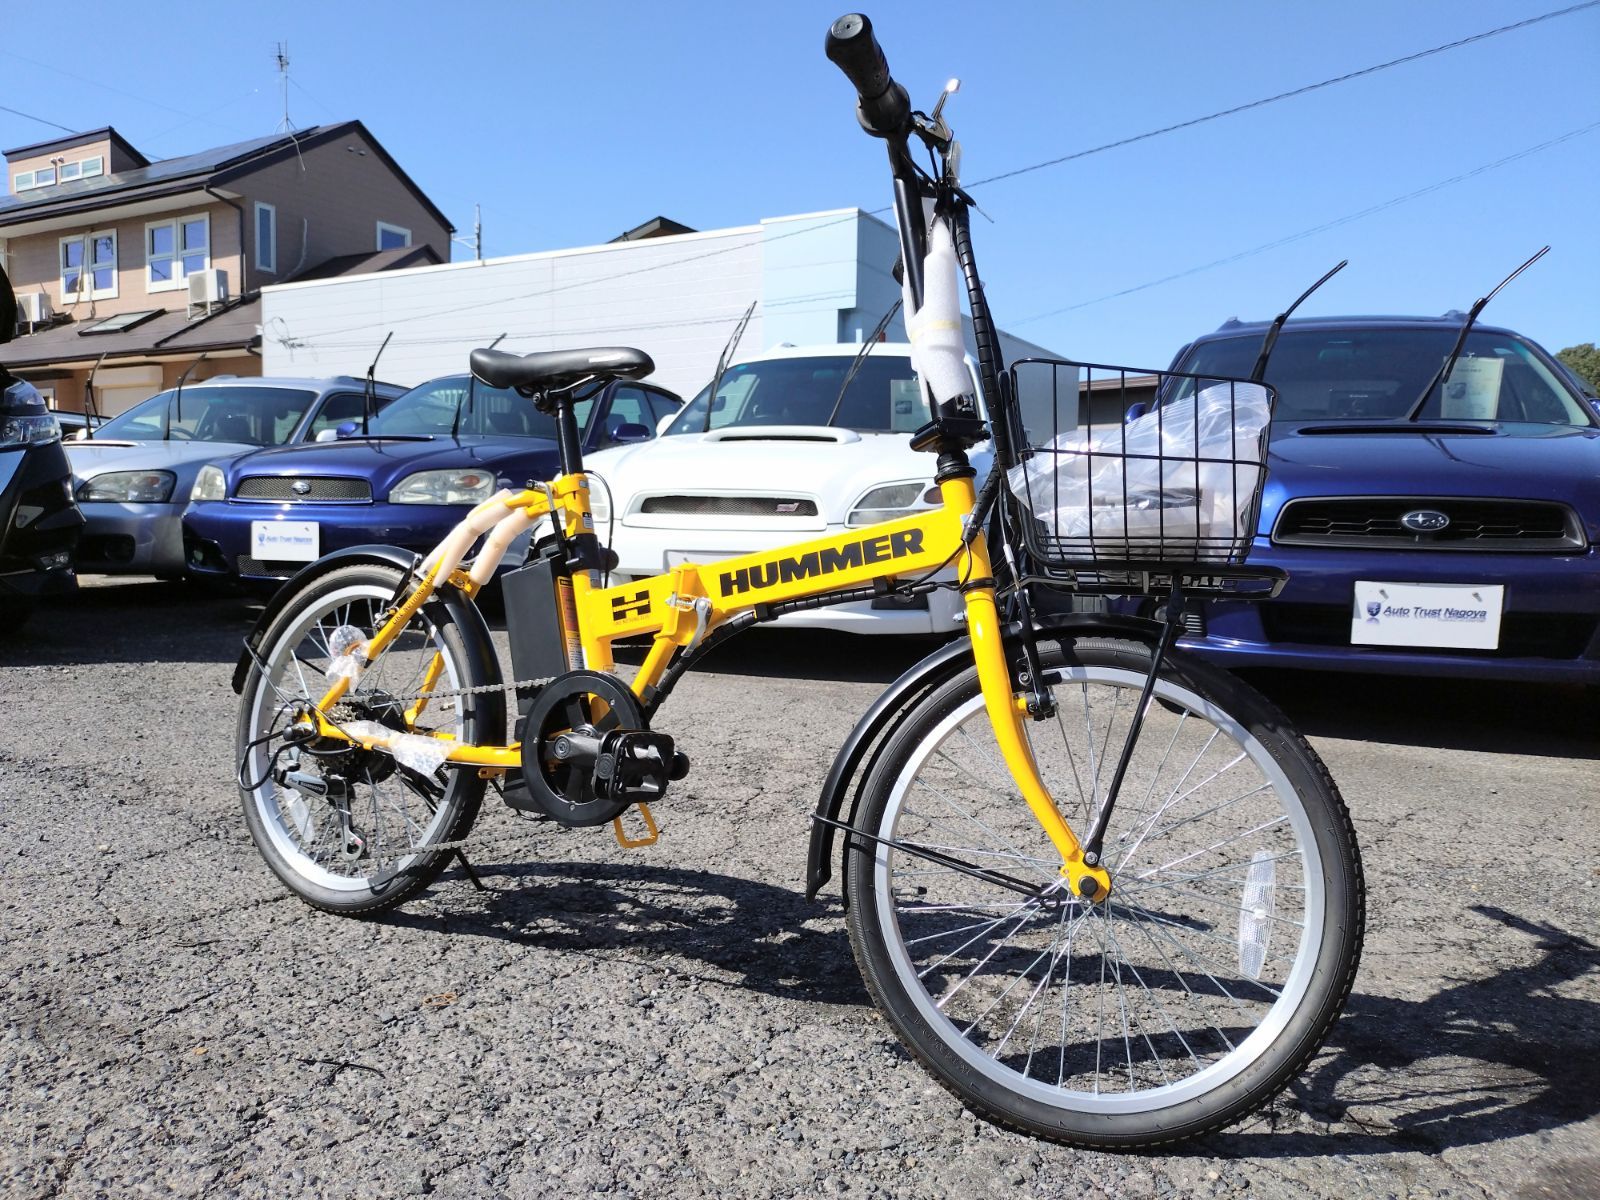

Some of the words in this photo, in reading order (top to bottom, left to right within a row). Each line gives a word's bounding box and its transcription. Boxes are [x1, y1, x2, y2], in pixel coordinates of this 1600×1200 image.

[719, 528, 925, 598] HUMMER
[1383, 606, 1410, 615] Auto
[1413, 607, 1442, 617] Trust
[1444, 608, 1487, 619] Nagoya
